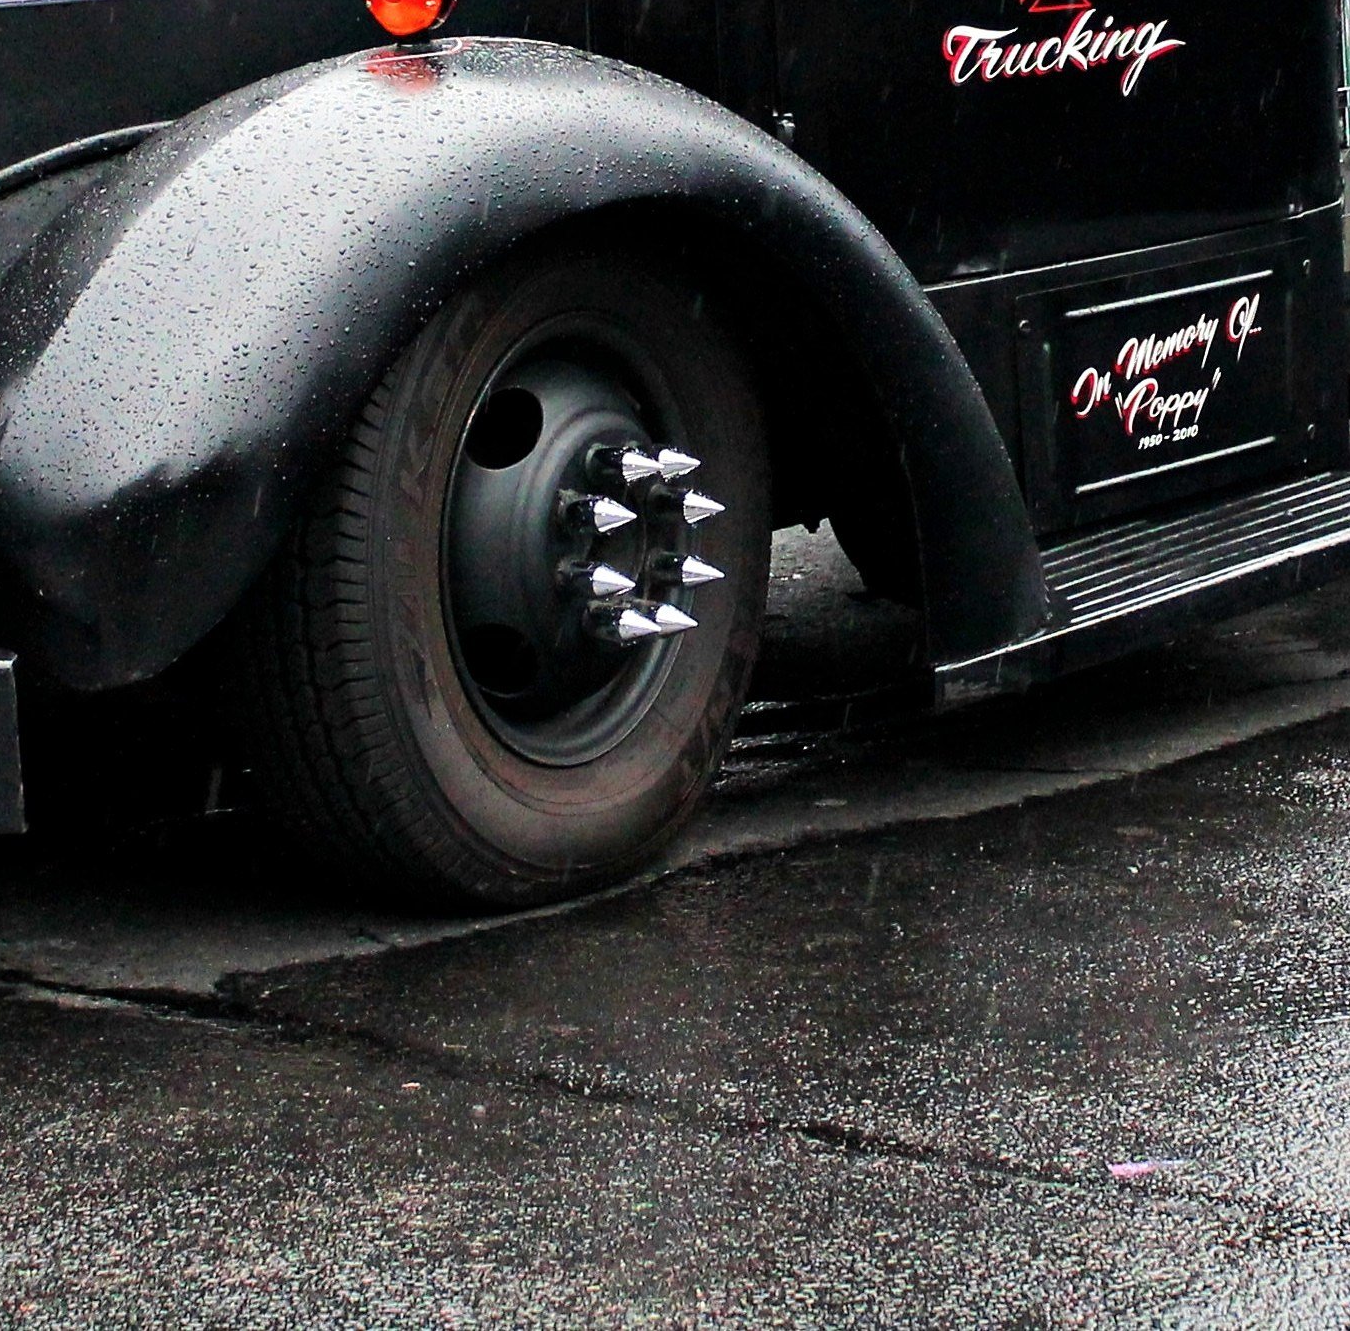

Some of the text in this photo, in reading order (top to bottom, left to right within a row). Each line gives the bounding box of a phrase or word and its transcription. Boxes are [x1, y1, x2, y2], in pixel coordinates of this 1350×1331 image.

[943, 8, 1187, 98] Trucking
[1070, 366, 1112, 420] In
[1114, 313, 1219, 381] Memory
